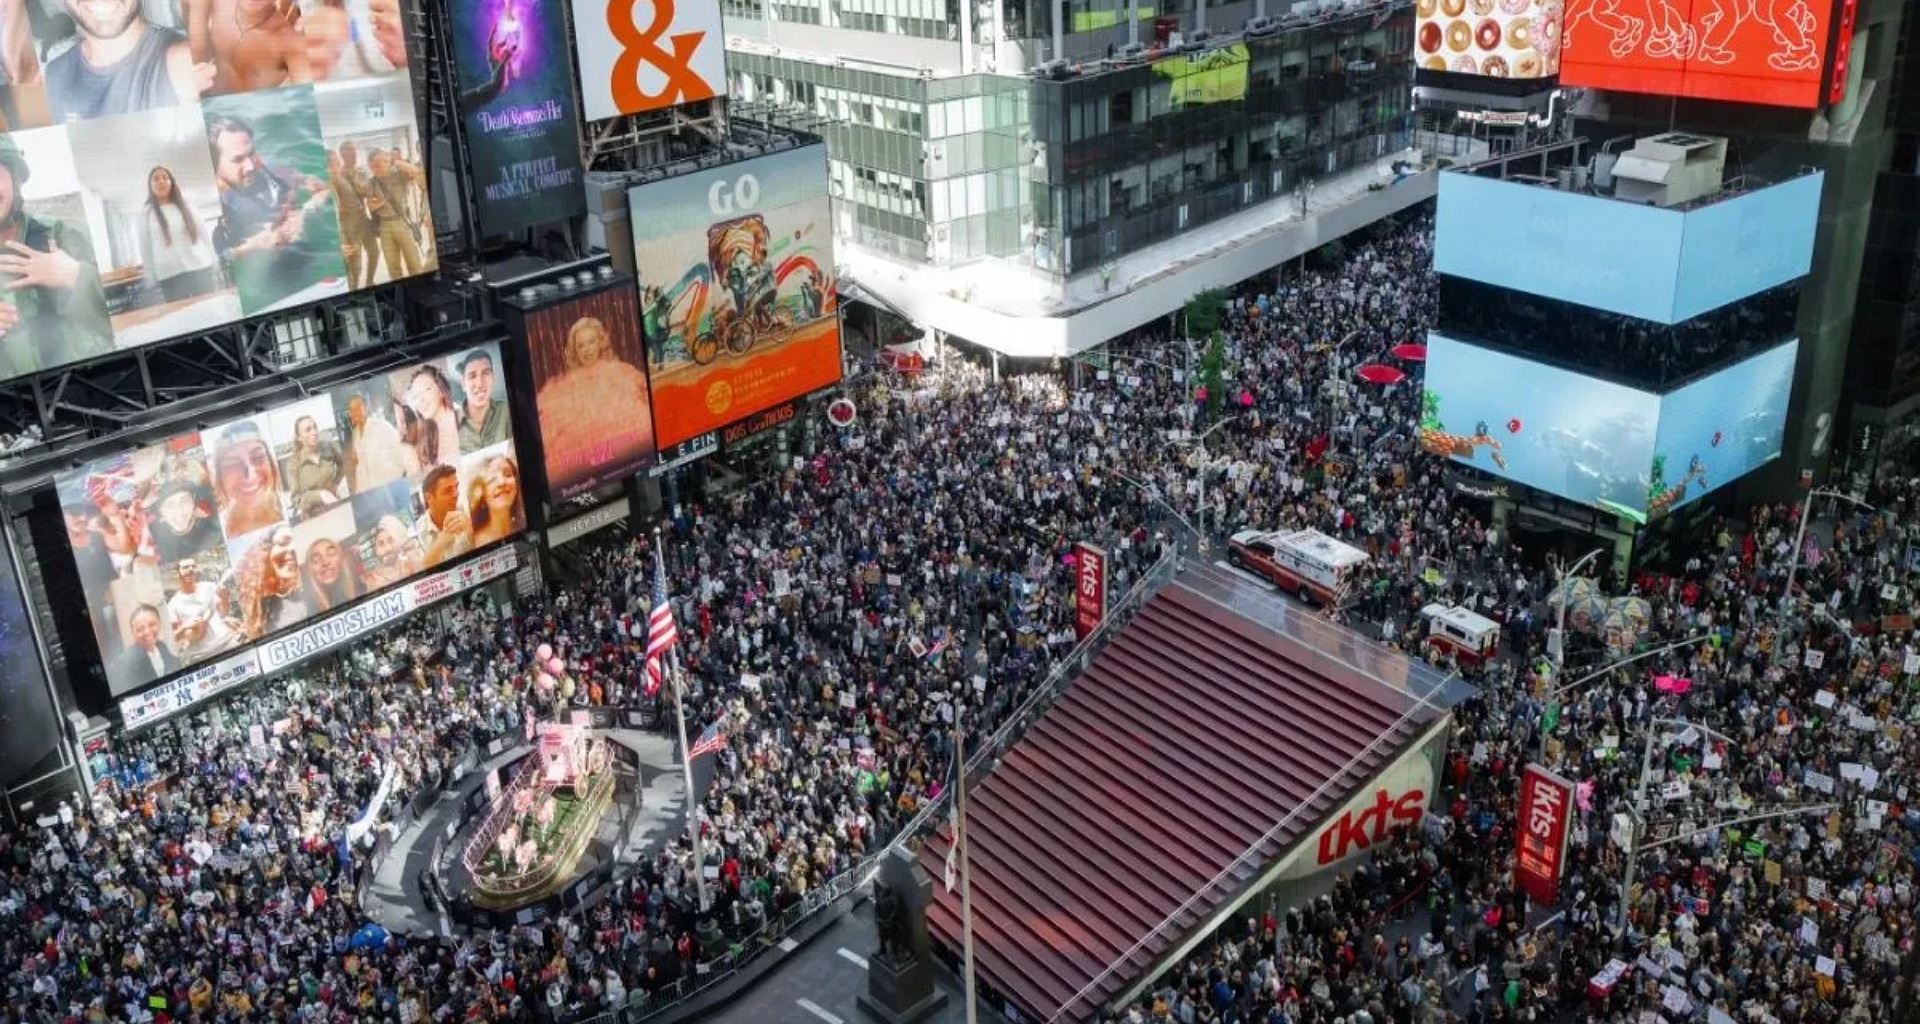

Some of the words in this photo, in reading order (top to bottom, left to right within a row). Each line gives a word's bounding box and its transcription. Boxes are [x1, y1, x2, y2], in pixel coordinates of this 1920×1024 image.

[708, 174, 760, 216] GO
[1317, 788, 1425, 866] tkts
[1530, 781, 1561, 838] tkts
